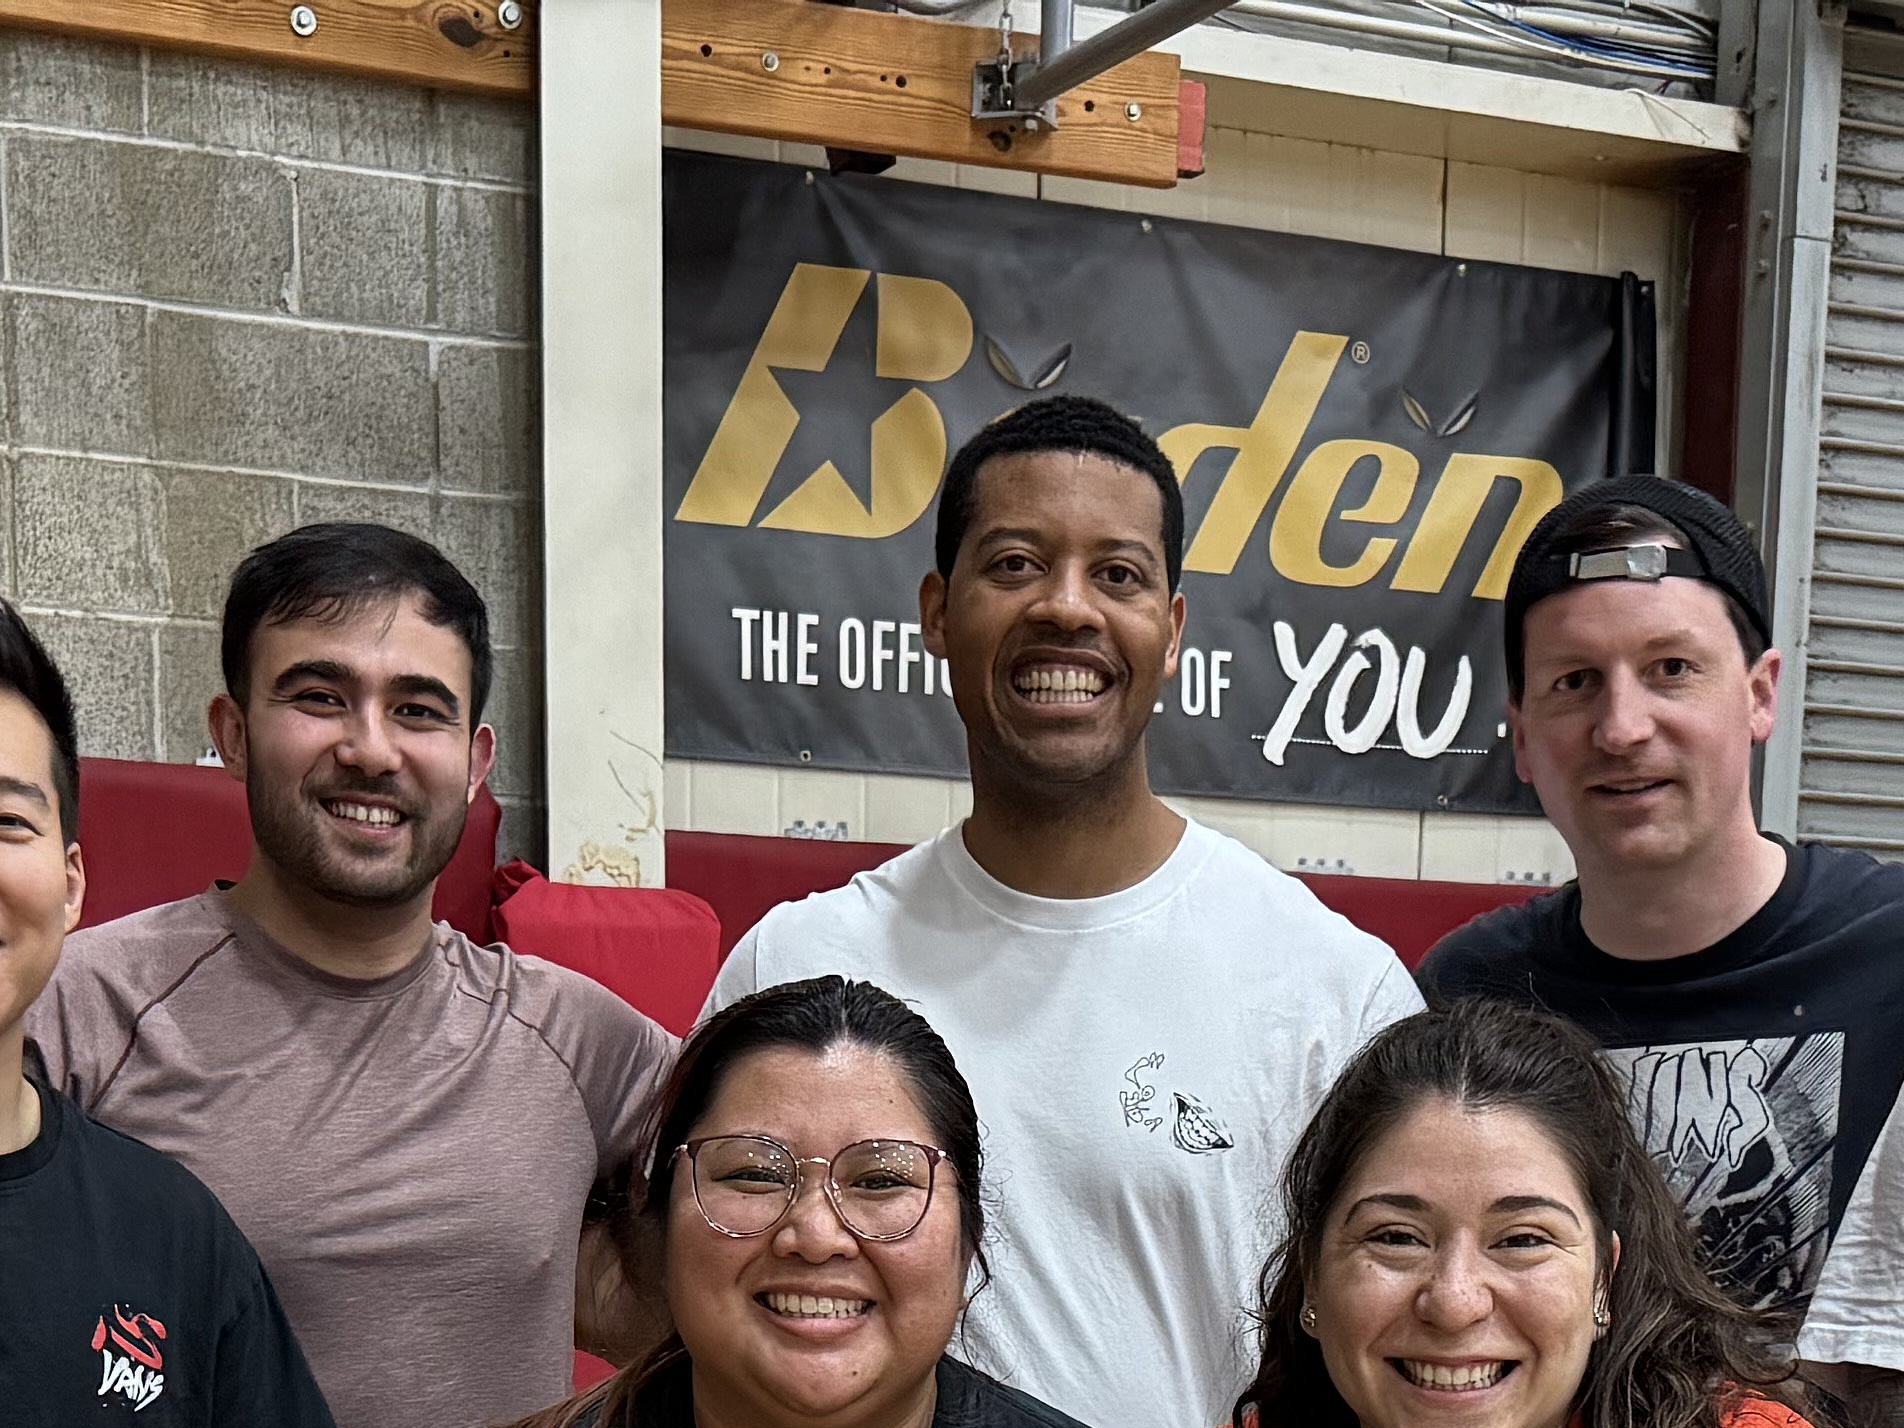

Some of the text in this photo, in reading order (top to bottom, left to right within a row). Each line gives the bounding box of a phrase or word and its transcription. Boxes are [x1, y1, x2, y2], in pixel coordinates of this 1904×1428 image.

[674, 262, 1564, 600] Bden
[731, 607, 819, 686] THE
[1181, 648, 1233, 719] OF
[98, 1348, 165, 1412] VANS
